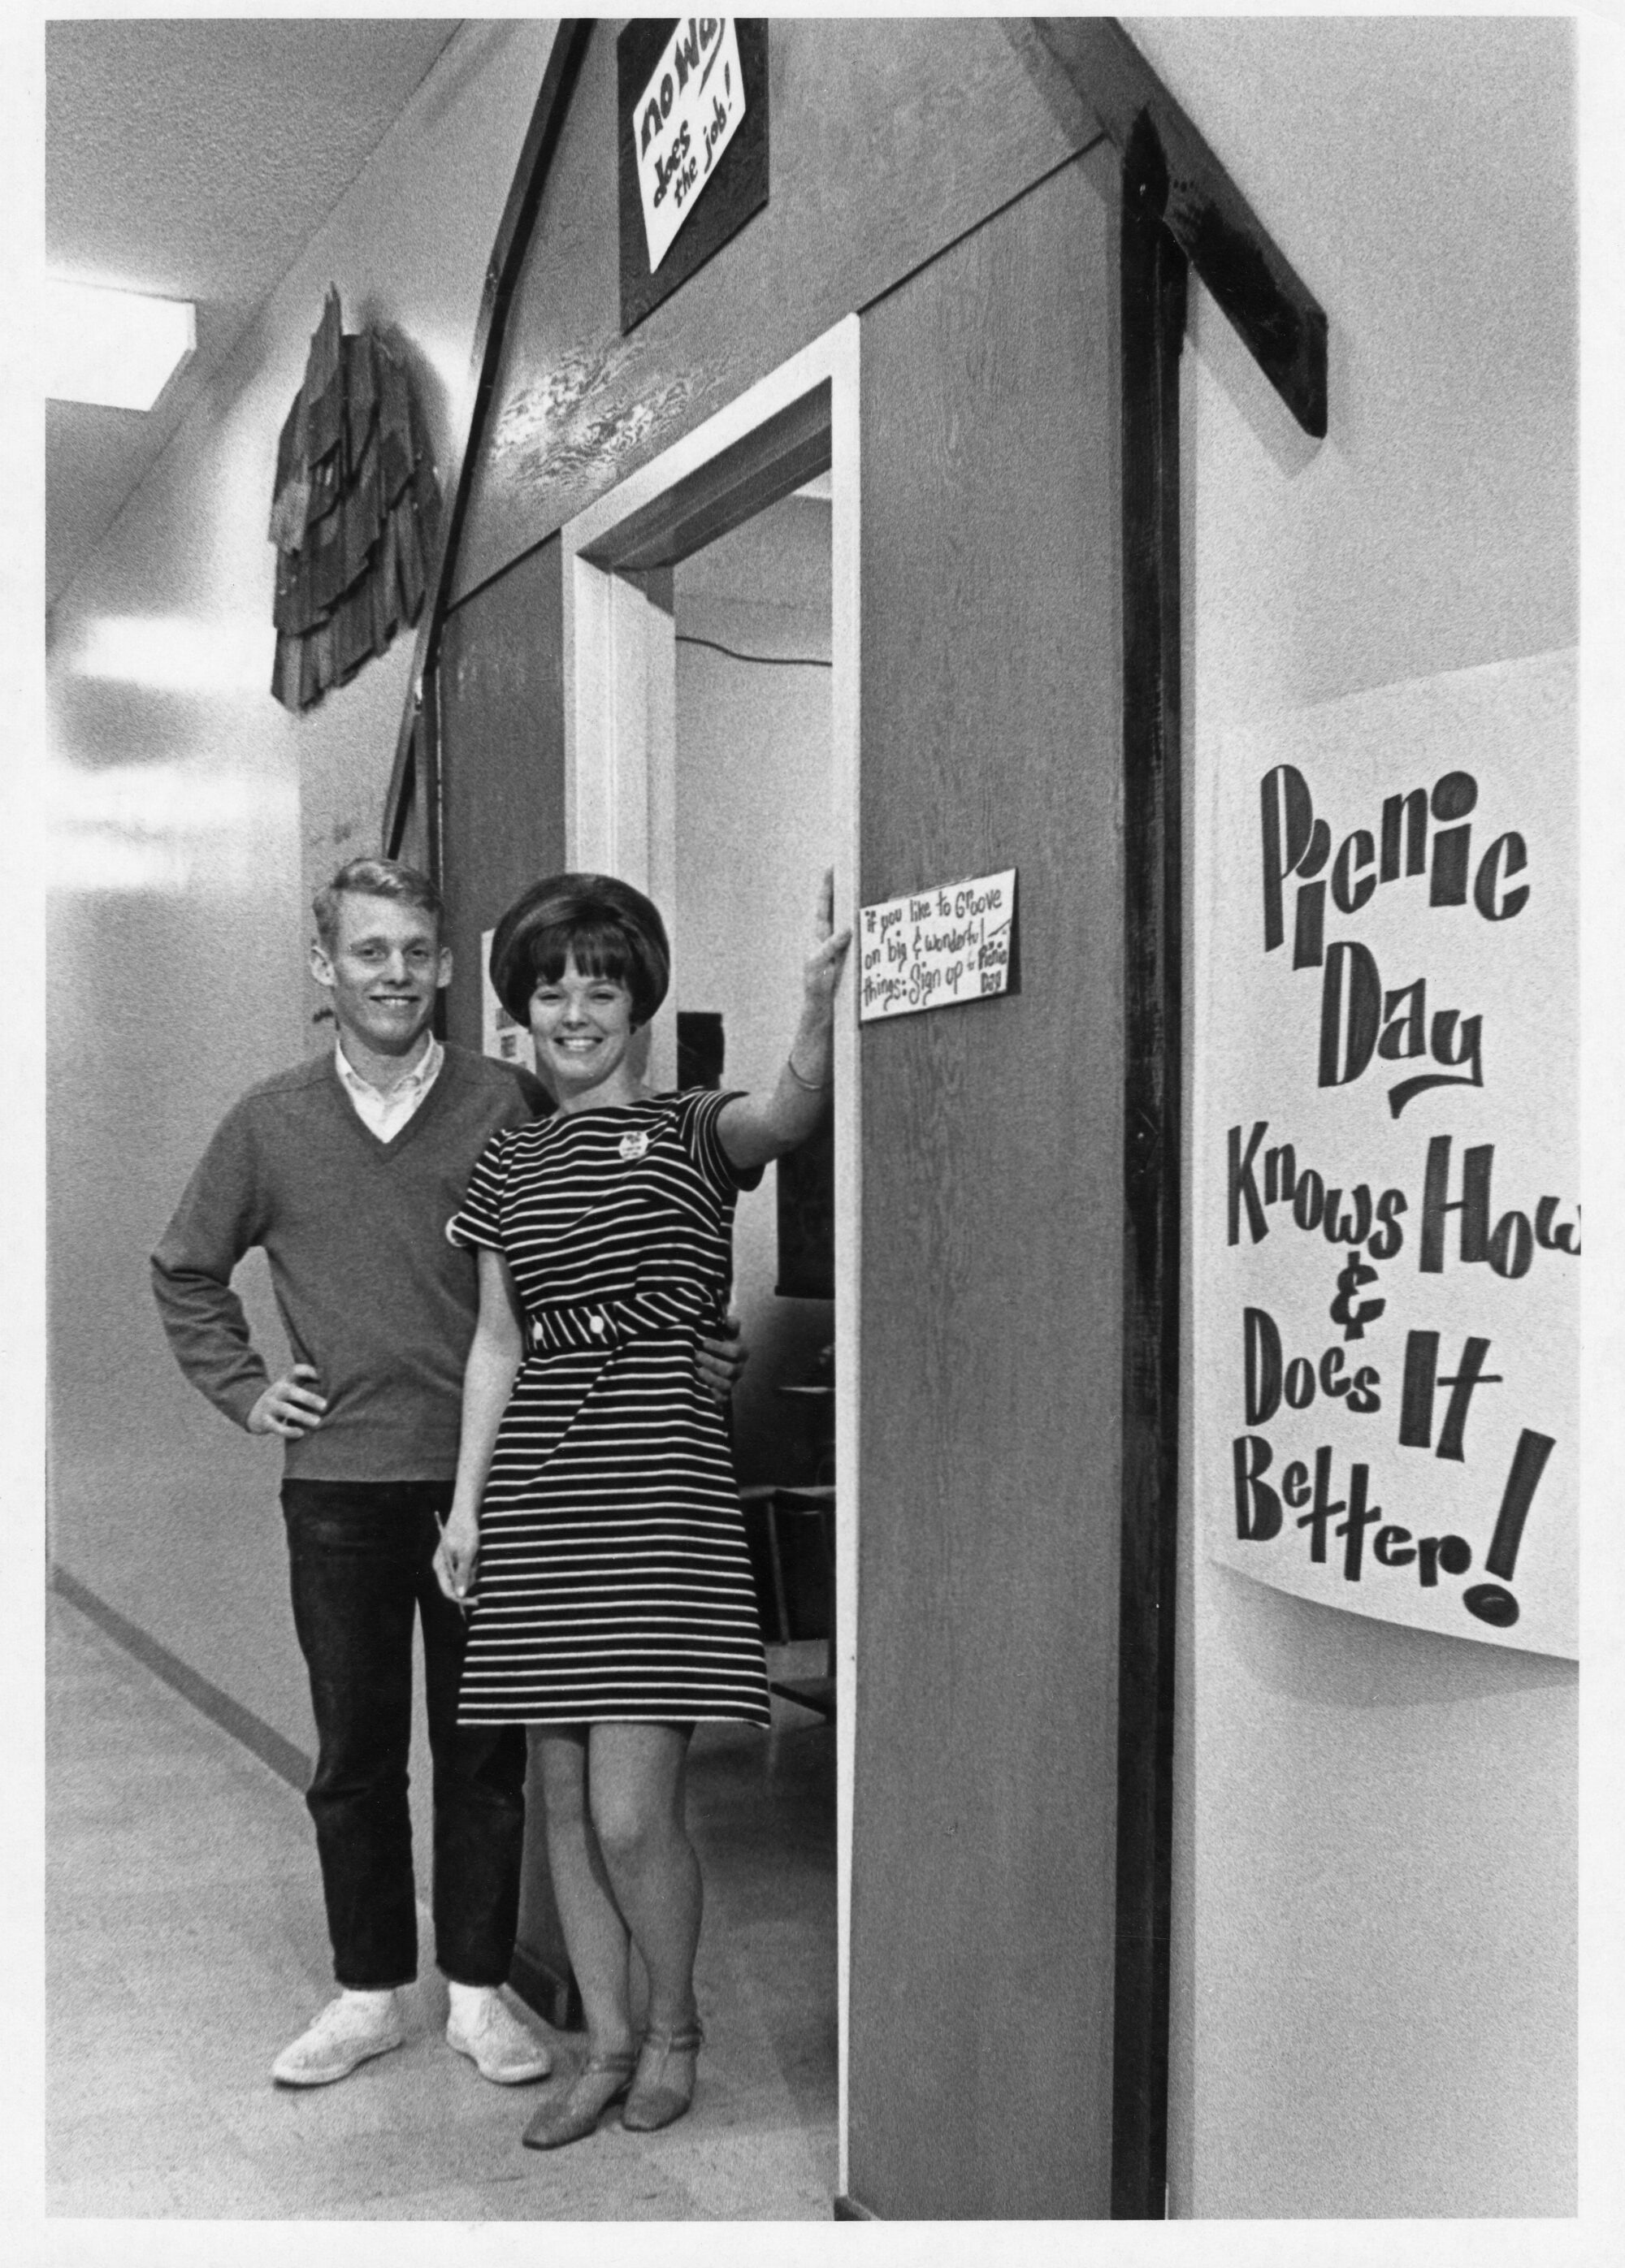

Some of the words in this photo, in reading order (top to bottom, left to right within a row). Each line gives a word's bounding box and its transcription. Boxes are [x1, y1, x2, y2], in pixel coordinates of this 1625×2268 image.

[641, 73, 674, 161] no
[653, 119, 691, 208] does
[674, 155, 698, 208] the
[1260, 764, 1531, 972] Picnic
[864, 949, 881, 970] on
[887, 929, 908, 973] big
[912, 925, 921, 960] &
[881, 908, 902, 944] you
[910, 898, 932, 922] like
[936, 890, 951, 916] to
[863, 974, 907, 1011] things:
[908, 961, 941, 1006] Sign
[945, 960, 963, 994] up
[1318, 941, 1484, 1119] Day
[1227, 1121, 1408, 1260] Knows
[1419, 1134, 1581, 1279] How
[1329, 1250, 1386, 1341] &
[1243, 1306, 1381, 1426] Does
[1398, 1330, 1503, 1462] It
